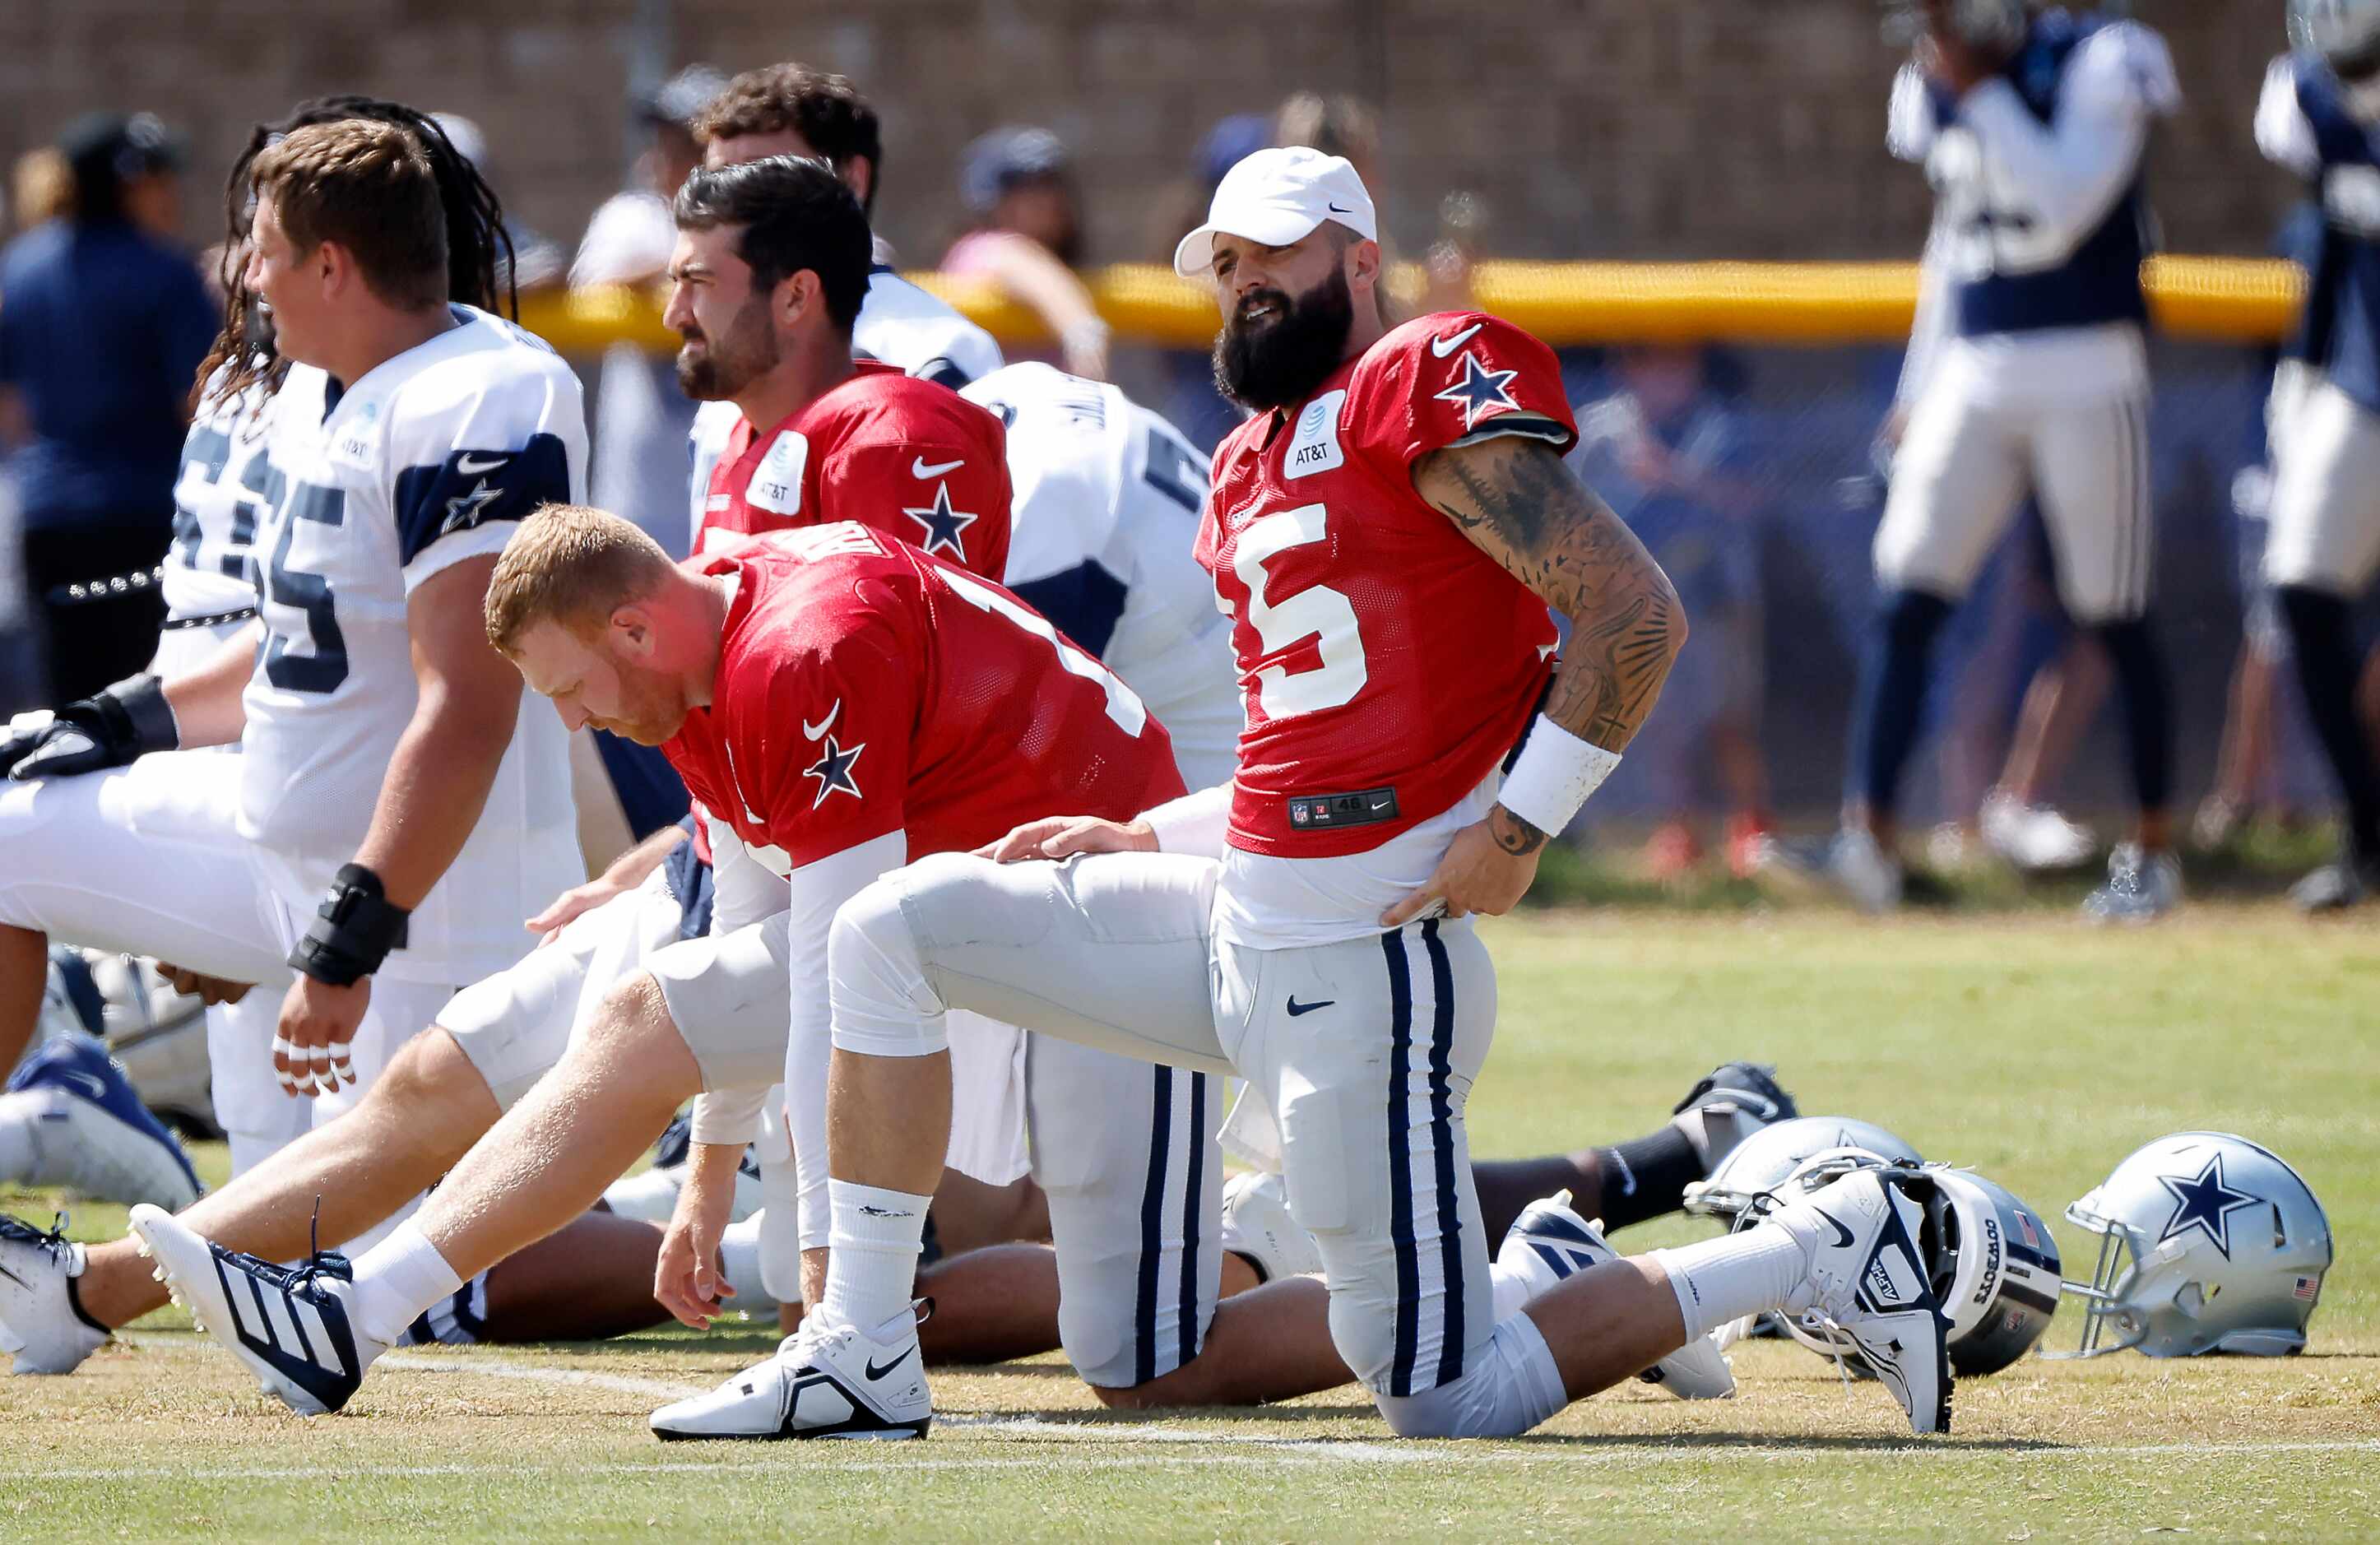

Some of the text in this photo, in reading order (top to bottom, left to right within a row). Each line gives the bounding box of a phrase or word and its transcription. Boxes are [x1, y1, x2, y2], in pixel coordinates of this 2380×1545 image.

[1296, 443, 1327, 466] AT&T
[1870, 1258, 1898, 1298] ALPHA
[1973, 1219, 1999, 1304] COWBOYS
